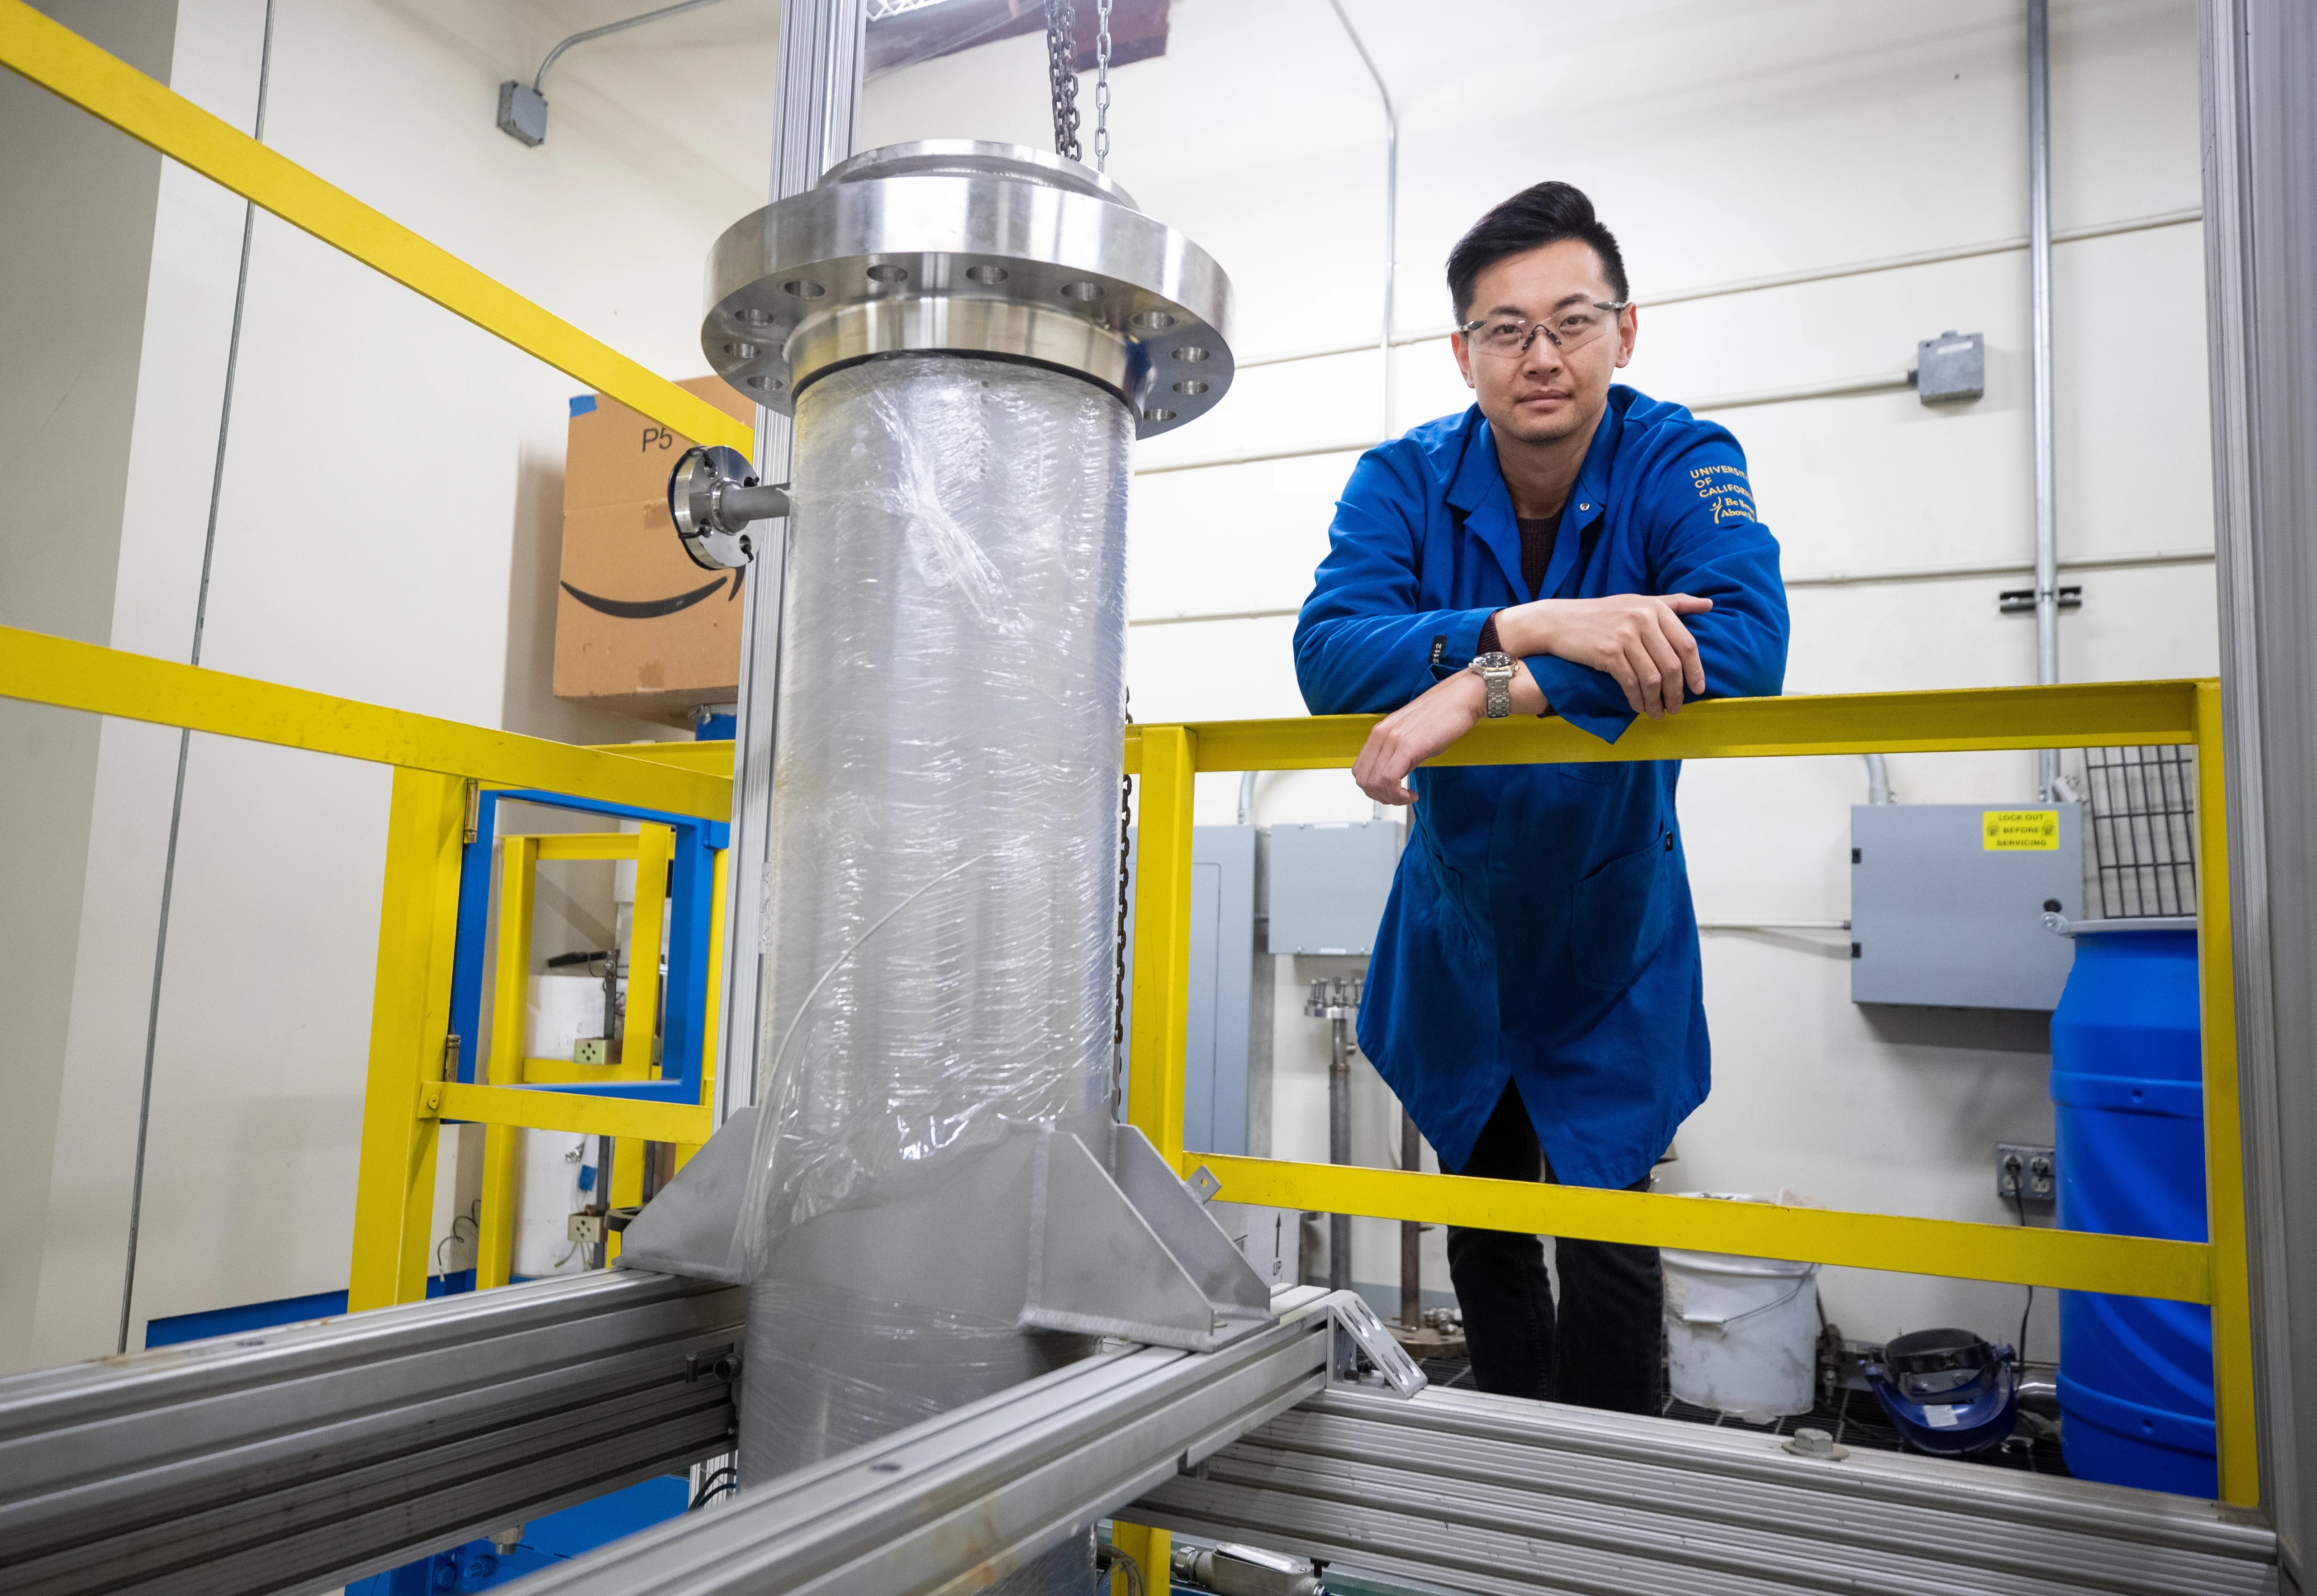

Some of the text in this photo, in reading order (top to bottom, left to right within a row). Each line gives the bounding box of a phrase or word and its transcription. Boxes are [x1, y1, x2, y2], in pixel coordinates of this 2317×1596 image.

[642, 427, 673, 452] P5
[1695, 477, 1712, 488] OF
[1724, 498, 1738, 506] Be
[1432, 643, 1442, 664] 2112
[1273, 1260, 1282, 1276] UP
